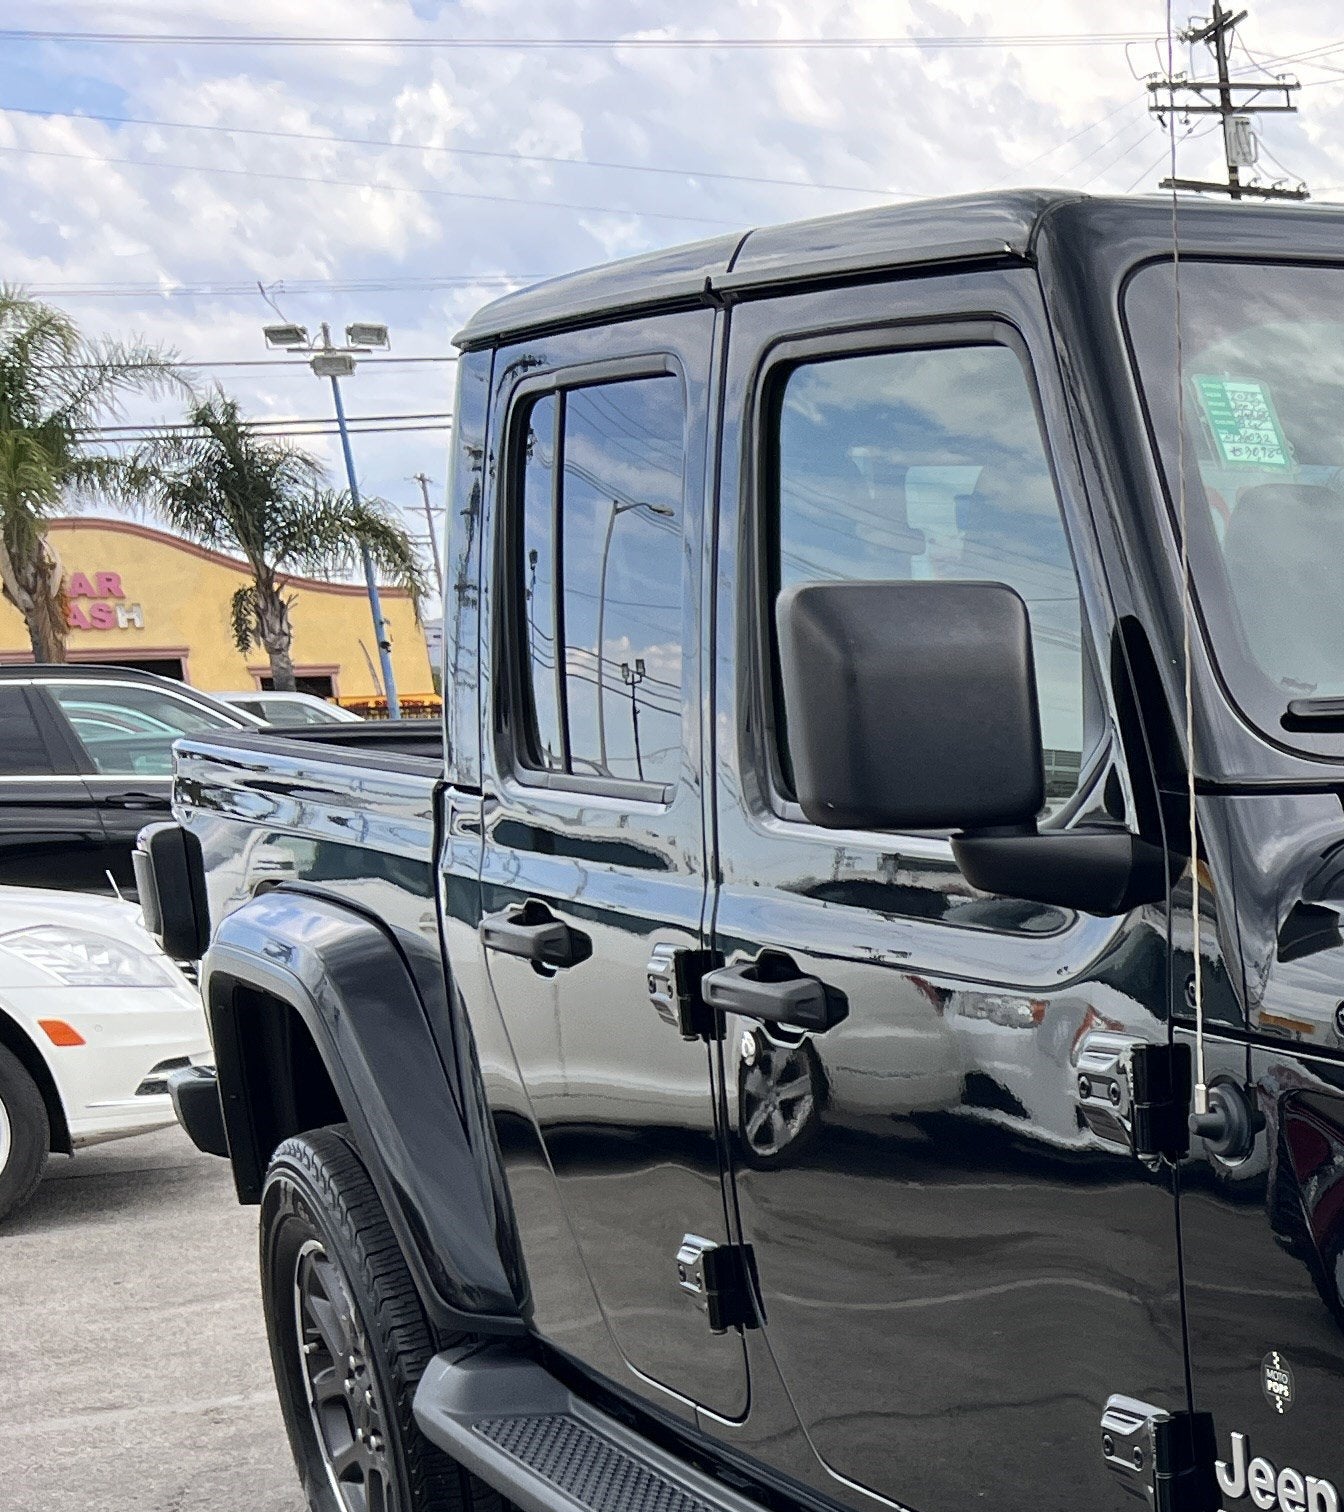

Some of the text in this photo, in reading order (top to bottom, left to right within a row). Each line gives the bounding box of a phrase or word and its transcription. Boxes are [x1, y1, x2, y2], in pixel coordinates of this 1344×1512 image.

[69, 571, 126, 598] AR
[68, 602, 145, 630] ASH
[1265, 1368, 1289, 1384] MOTO
[1266, 1379, 1290, 1397] POPS
